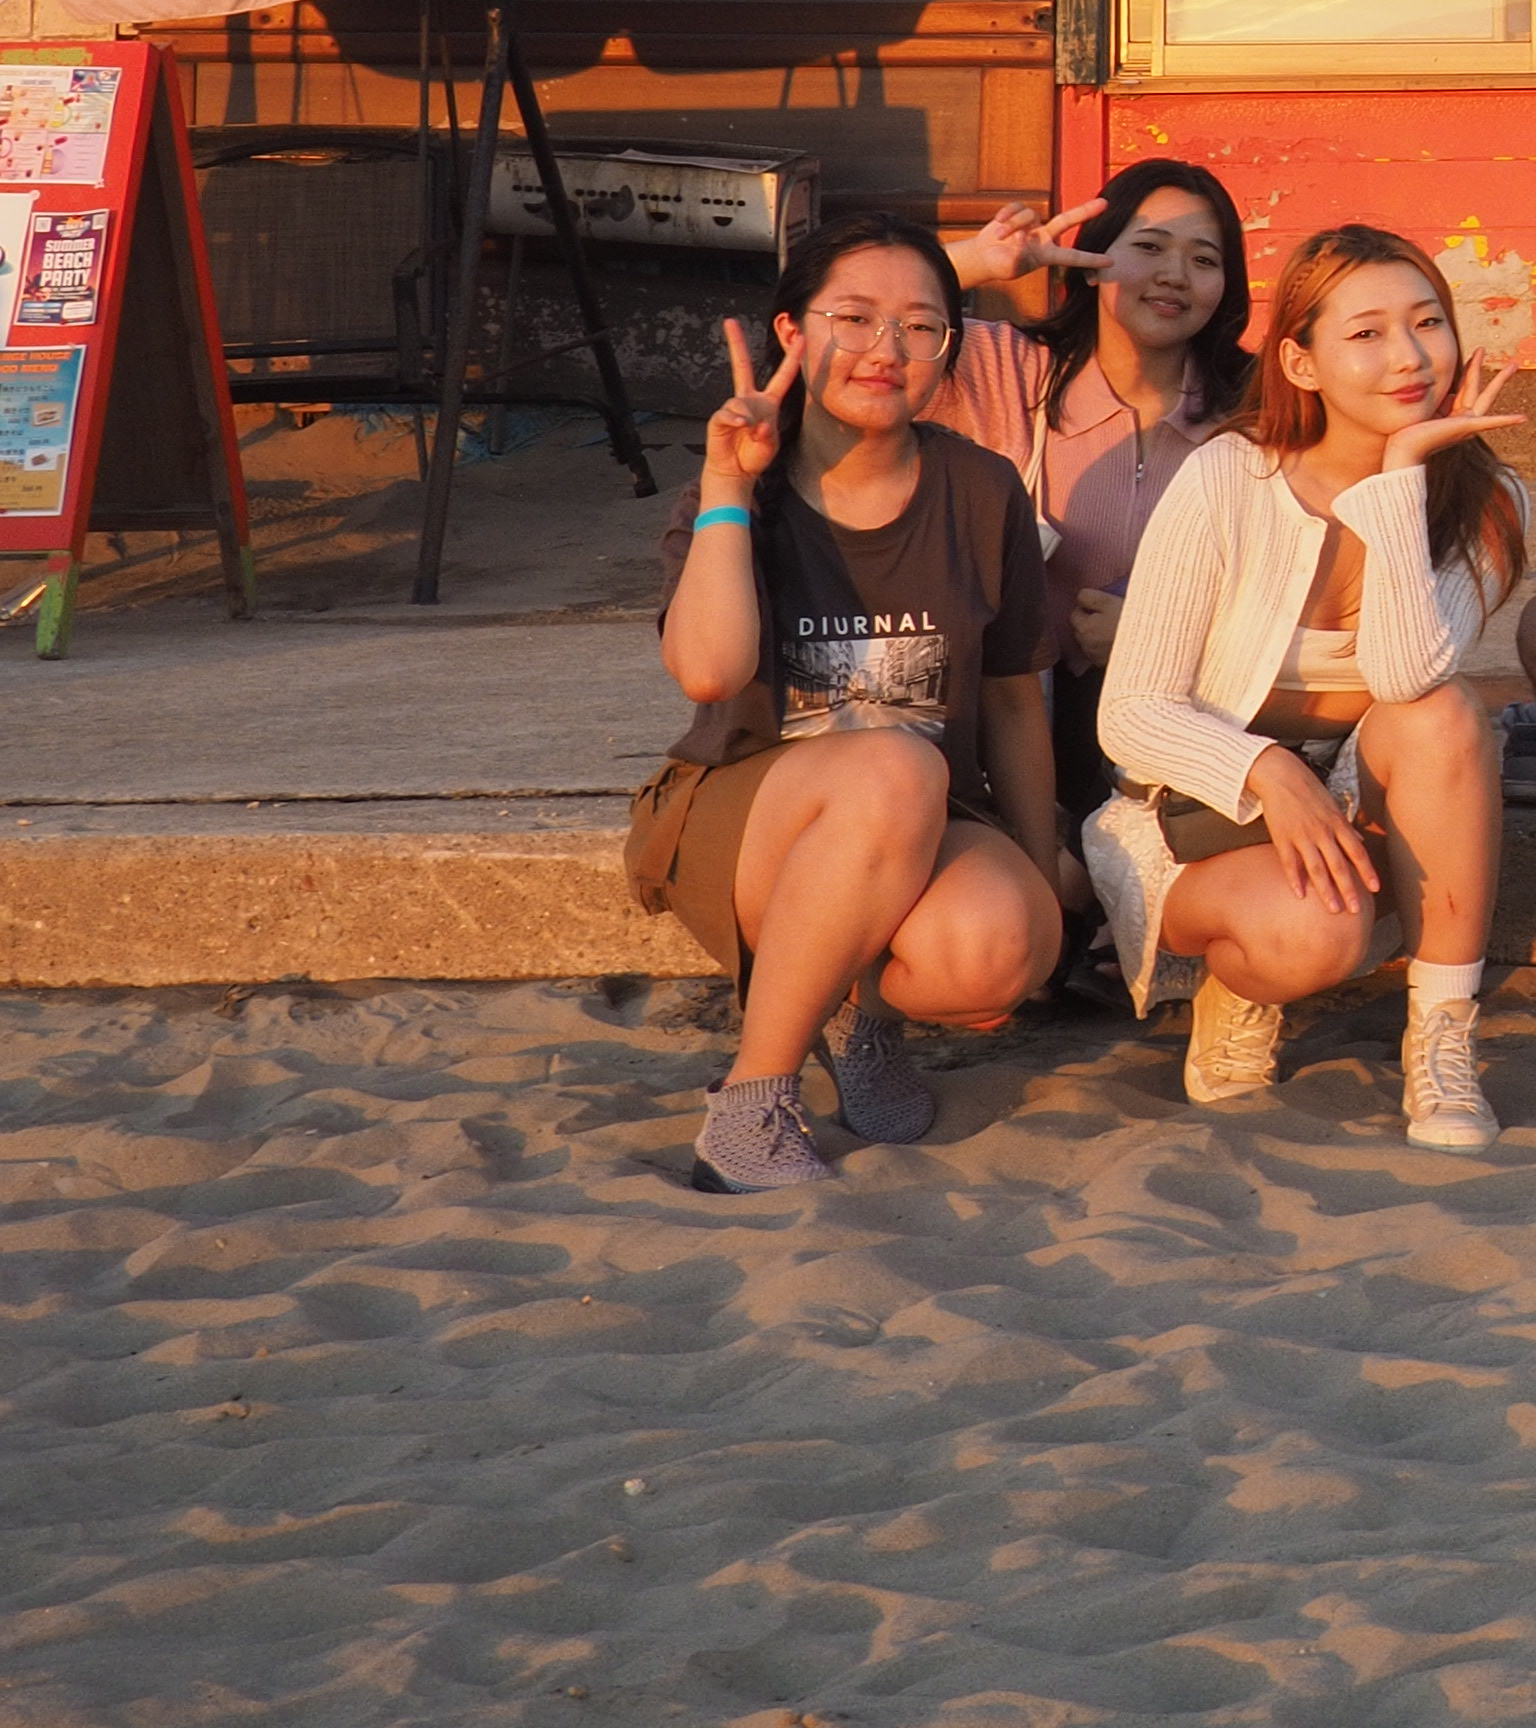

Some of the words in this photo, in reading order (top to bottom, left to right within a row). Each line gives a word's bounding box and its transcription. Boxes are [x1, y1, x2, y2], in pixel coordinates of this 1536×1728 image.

[44, 238, 95, 252] SUMMER
[42, 251, 94, 269] BEACH
[39, 268, 91, 287] PARTY
[799, 611, 937, 636] DIURNAL
